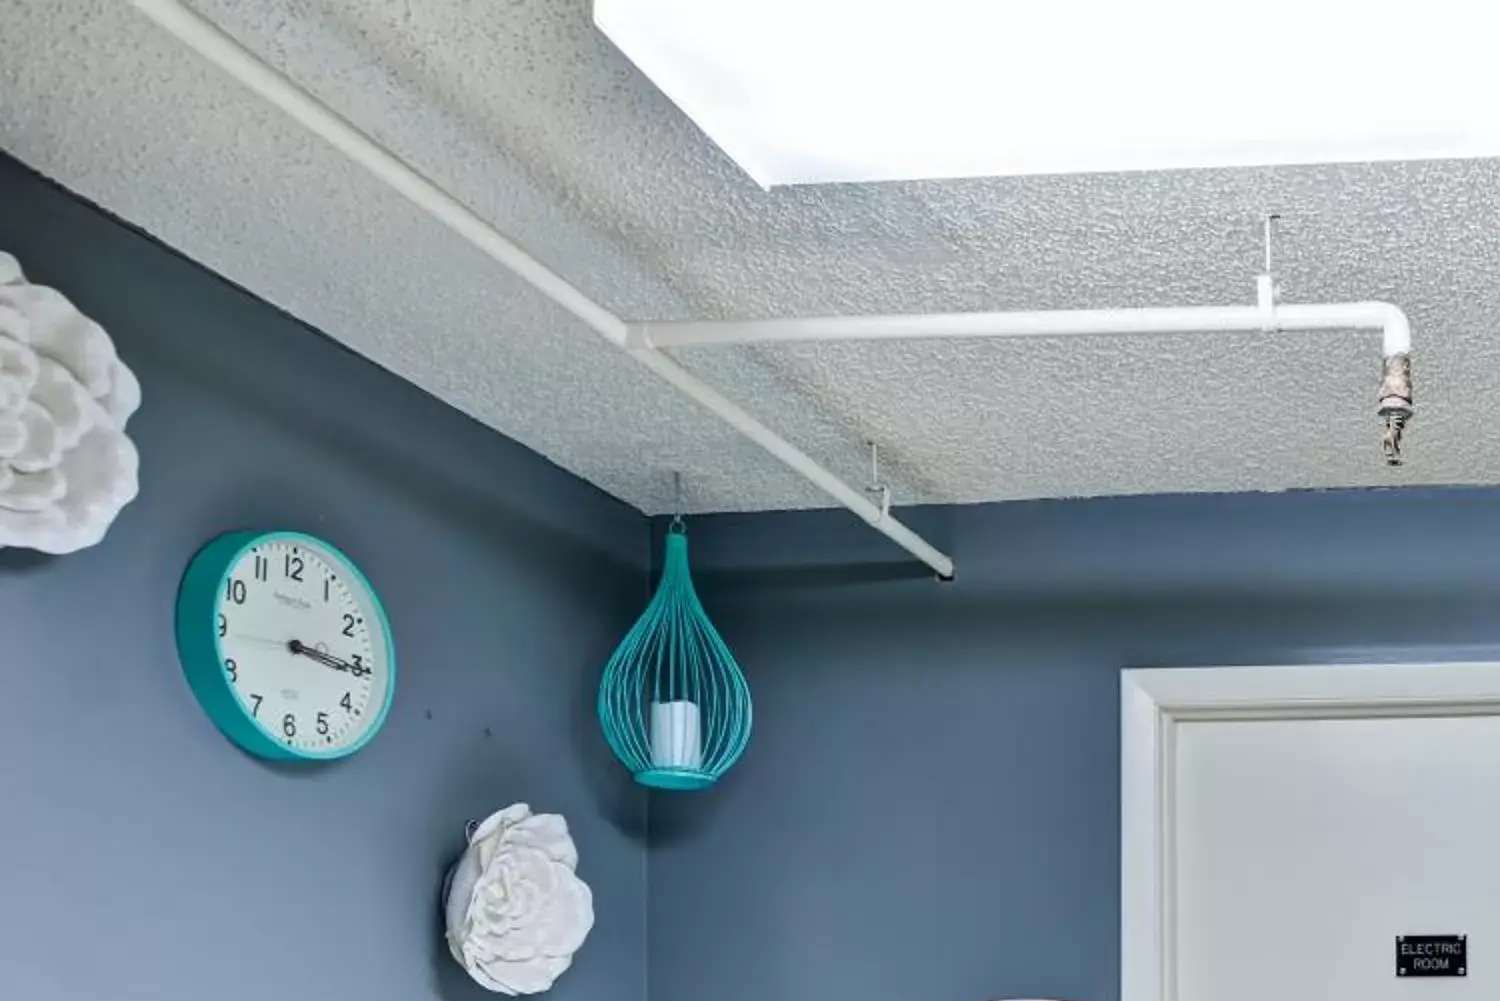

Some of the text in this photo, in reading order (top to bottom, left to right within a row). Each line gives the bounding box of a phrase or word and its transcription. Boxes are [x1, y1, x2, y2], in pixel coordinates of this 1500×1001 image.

[255, 555, 268, 582] 11
[285, 554, 305, 582] 12
[227, 577, 247, 604] 10
[323, 580, 329, 602] 1
[217, 613, 228, 637] 9
[342, 614, 355, 637] 2
[224, 659, 237, 683] 8
[351, 654, 364, 677] 3
[250, 694, 263, 718] 7
[340, 692, 353, 713] 4
[283, 714, 296, 737] 6
[316, 712, 329, 735] 5
[1401, 943, 1462, 955] ELECTRIC
[1413, 957, 1449, 970] ROOM
